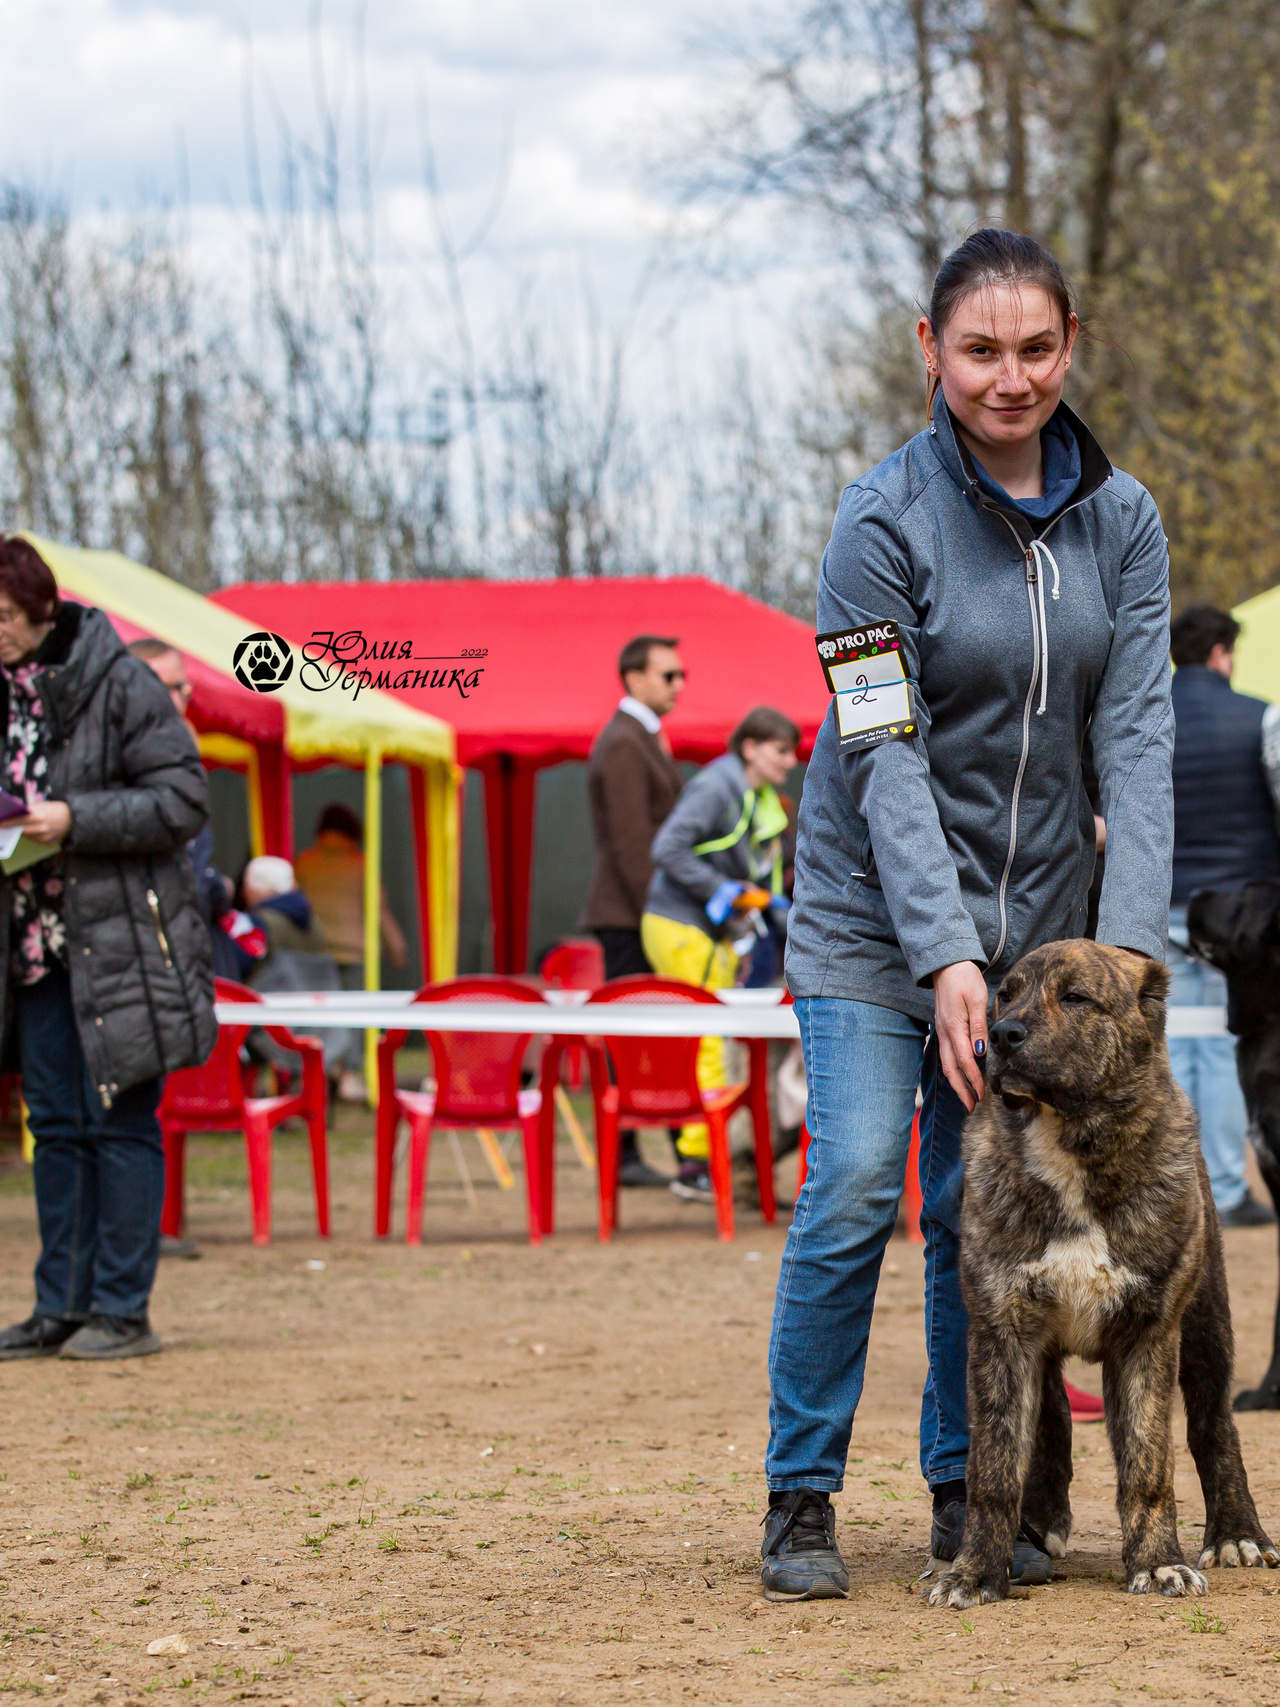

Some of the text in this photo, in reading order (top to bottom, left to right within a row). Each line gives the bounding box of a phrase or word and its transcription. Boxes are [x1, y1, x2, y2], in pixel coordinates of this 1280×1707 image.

[836, 625, 895, 651] PRO PAC
[852, 674, 877, 705] 2
